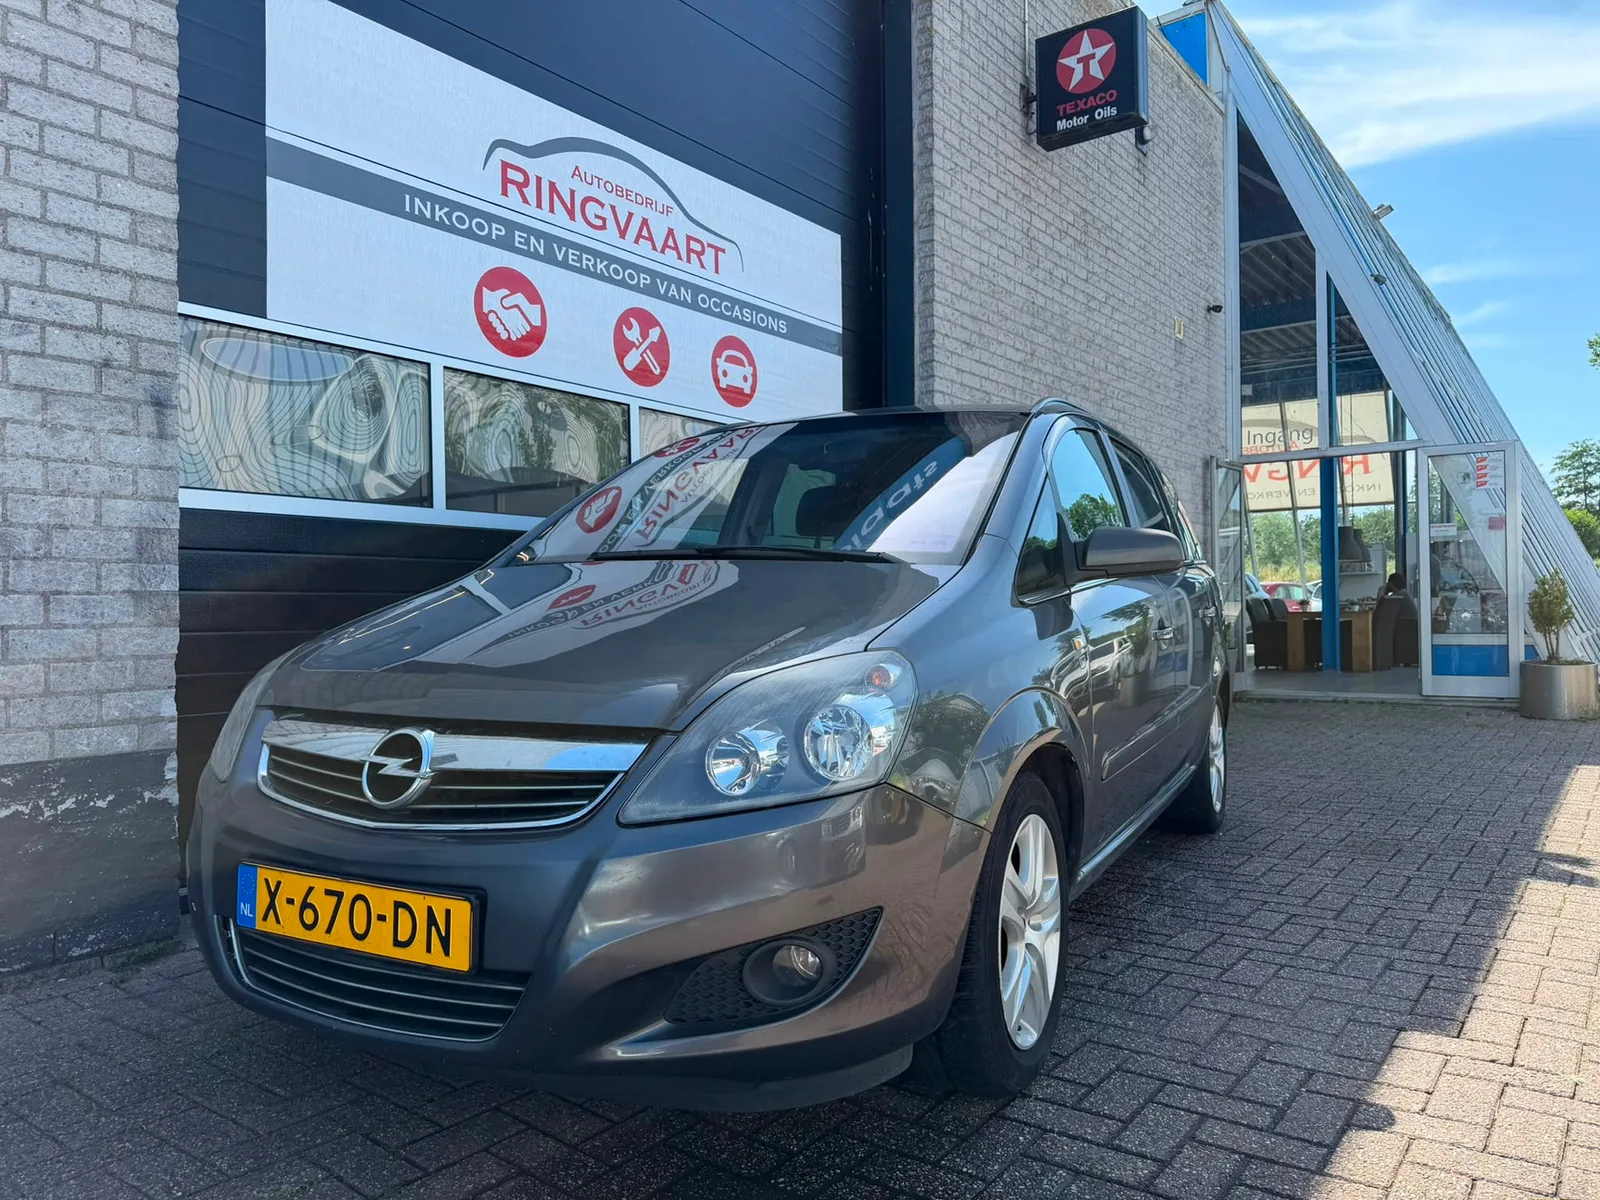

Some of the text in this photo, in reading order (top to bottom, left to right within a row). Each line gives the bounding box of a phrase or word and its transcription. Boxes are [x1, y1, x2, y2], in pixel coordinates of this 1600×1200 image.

[1056, 106, 1118, 131] Motor Oils
[1057, 89, 1118, 117] TEXACO
[570, 164, 674, 217] AUTOBEDRIJF
[499, 158, 727, 276] RINGVAART
[404, 193, 788, 334] INKOOP EN VERKOOP VAN OCCASIONS
[1247, 427, 1314, 448] Ingang
[240, 902, 254, 918] NL
[261, 877, 452, 958] X-670-DN
